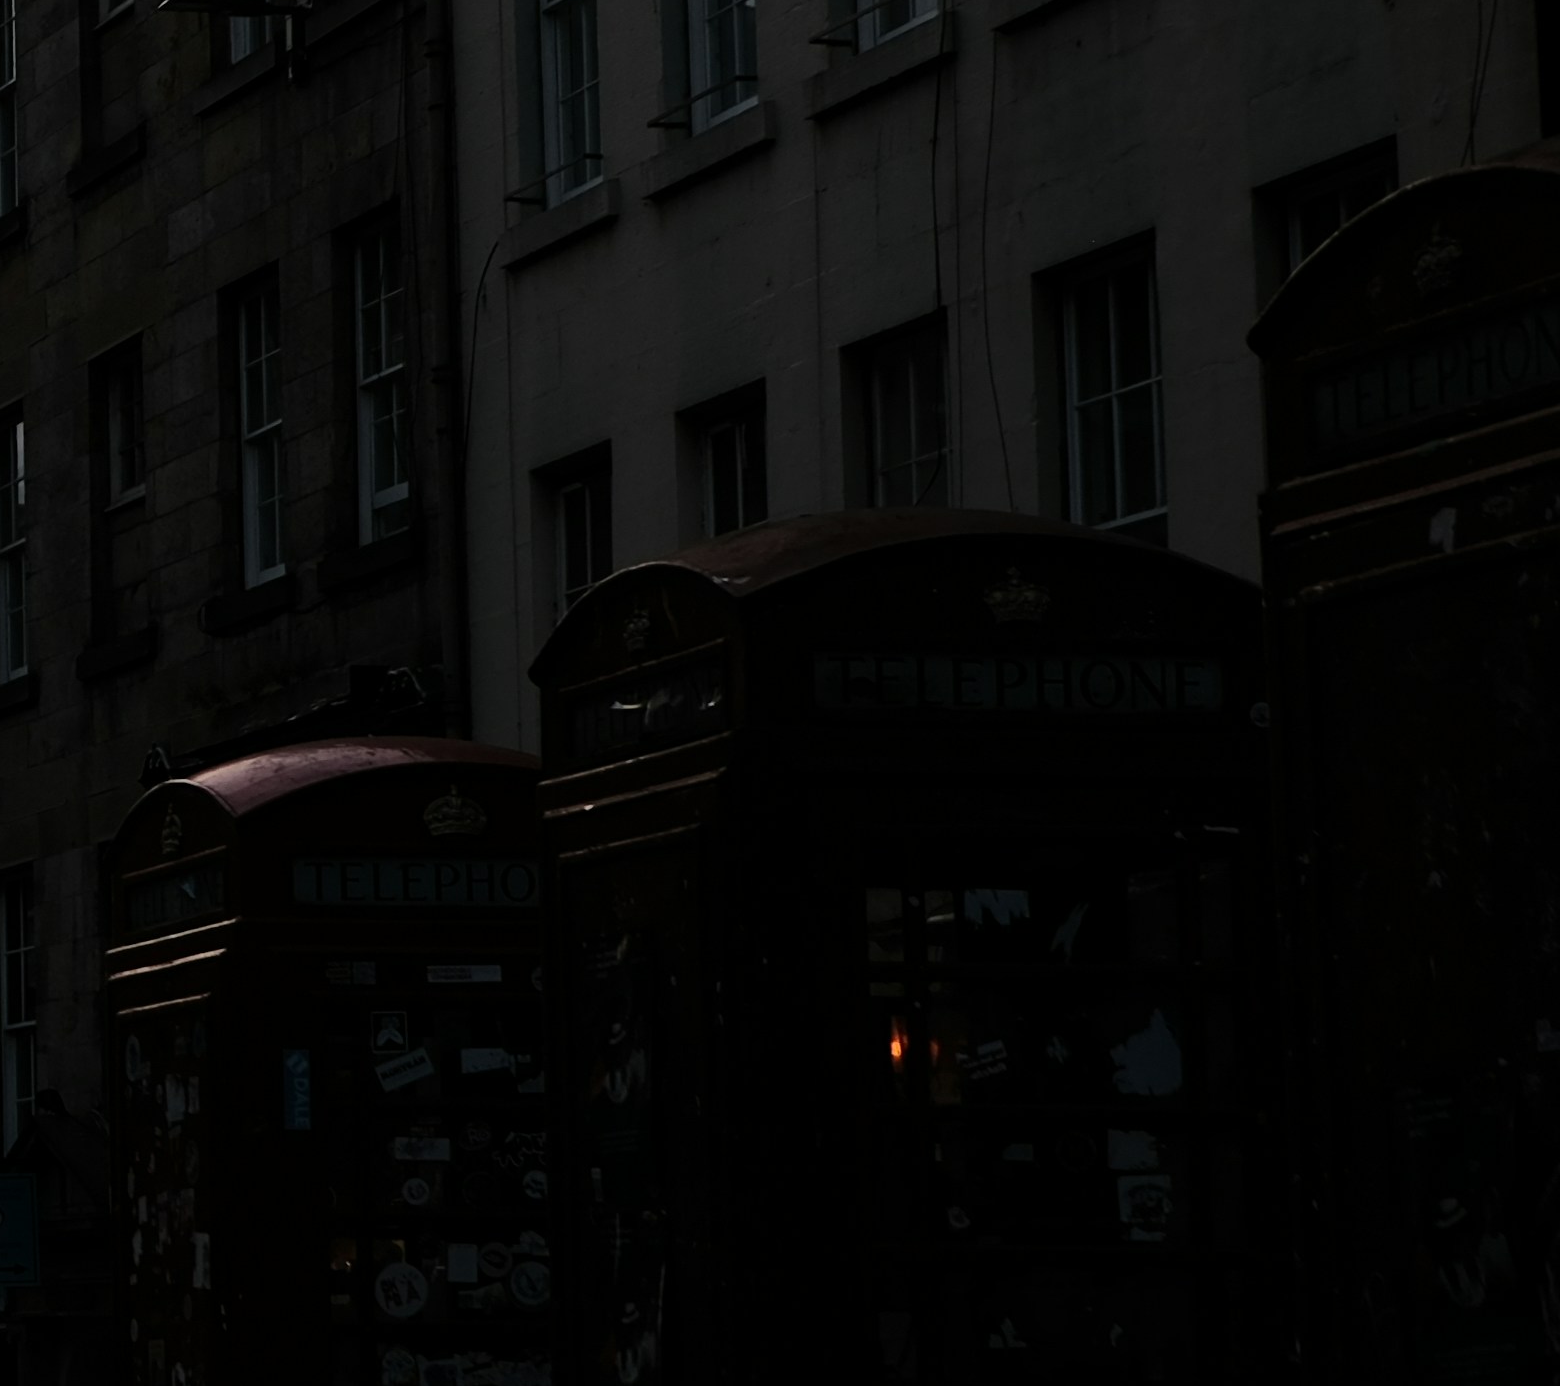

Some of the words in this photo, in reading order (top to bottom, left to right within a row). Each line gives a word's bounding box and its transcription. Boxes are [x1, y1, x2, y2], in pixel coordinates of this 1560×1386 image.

[1322, 308, 1560, 433] TELEPHON
[827, 654, 1207, 711] TELEPHONE
[303, 861, 537, 902] TELEPHO
